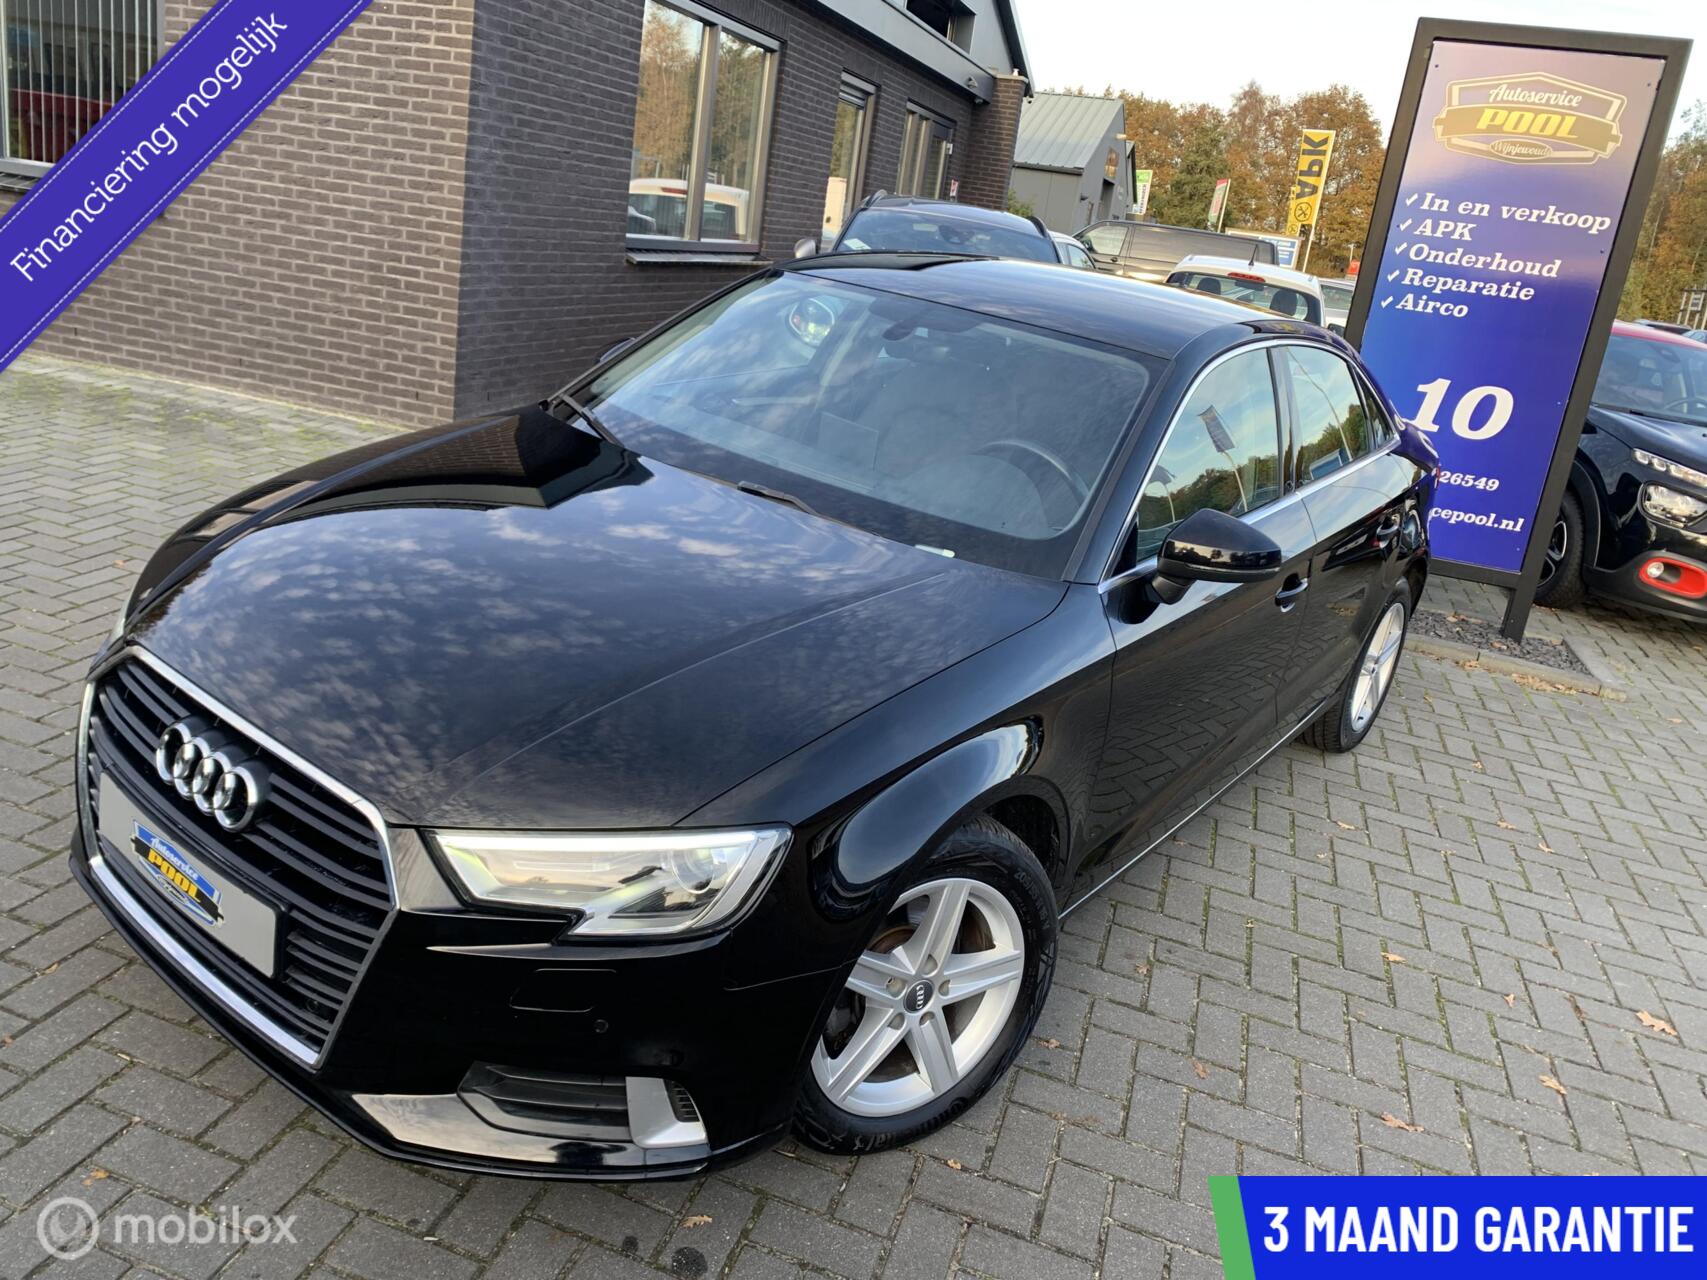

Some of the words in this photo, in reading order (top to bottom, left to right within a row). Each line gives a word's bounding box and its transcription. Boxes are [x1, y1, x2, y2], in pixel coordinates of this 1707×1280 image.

[1488, 83, 1583, 107] Autoservice
[1476, 107, 1580, 139] POOL
[1414, 218, 1477, 241] APK
[1419, 192, 1449, 213] In
[1458, 200, 1489, 217] en
[1500, 205, 1612, 235] verkoop
[1408, 243, 1562, 278] Onderhoud
[1401, 268, 1535, 301] Reparatie
[1395, 293, 1469, 318] Airco
[1411, 378, 1514, 440] 10
[147, 847, 201, 904] POOL
